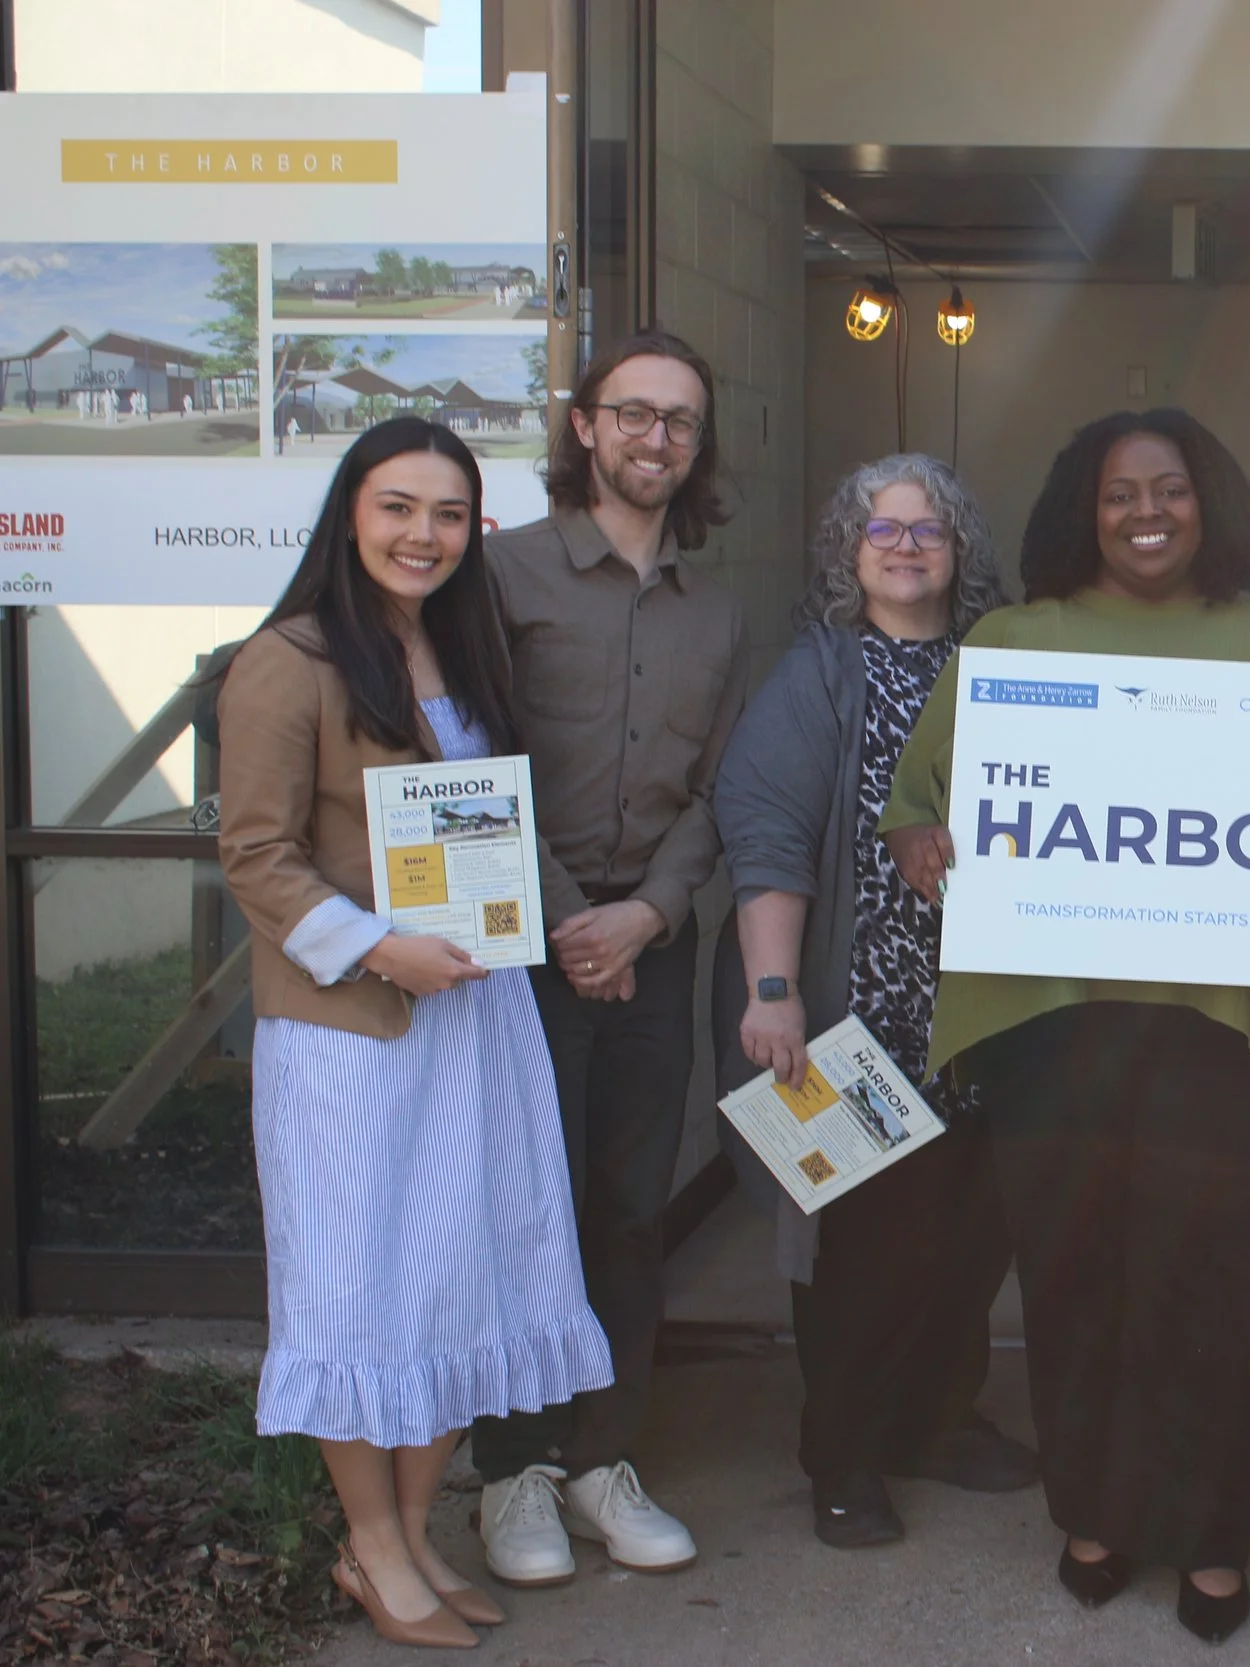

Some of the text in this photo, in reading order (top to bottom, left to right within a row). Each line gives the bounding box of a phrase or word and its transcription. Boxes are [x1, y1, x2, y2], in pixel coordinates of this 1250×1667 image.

[106, 152, 347, 173] THE HARBOR
[0, 512, 64, 537] SLAND
[155, 527, 262, 549] HARBOR,
[1002, 693, 1093, 705] FOUNDATION
[1003, 683, 1016, 693] The
[1018, 684, 1036, 694] Anne
[1044, 686, 1066, 697] Henry
[1067, 686, 1093, 697] Zarrow
[1150, 691, 1217, 709] Ruth Nelson
[402, 776, 420, 784] THE
[981, 762, 1051, 788] THE
[403, 779, 495, 801] HARBOR
[390, 825, 428, 838] 28,000
[404, 857, 427, 866] $16M
[408, 874, 426, 883] $1M
[1014, 903, 1179, 924] TRANSFORMATION
[1184, 911, 1248, 927] STARTS
[853, 1050, 910, 1118] HARBOR
